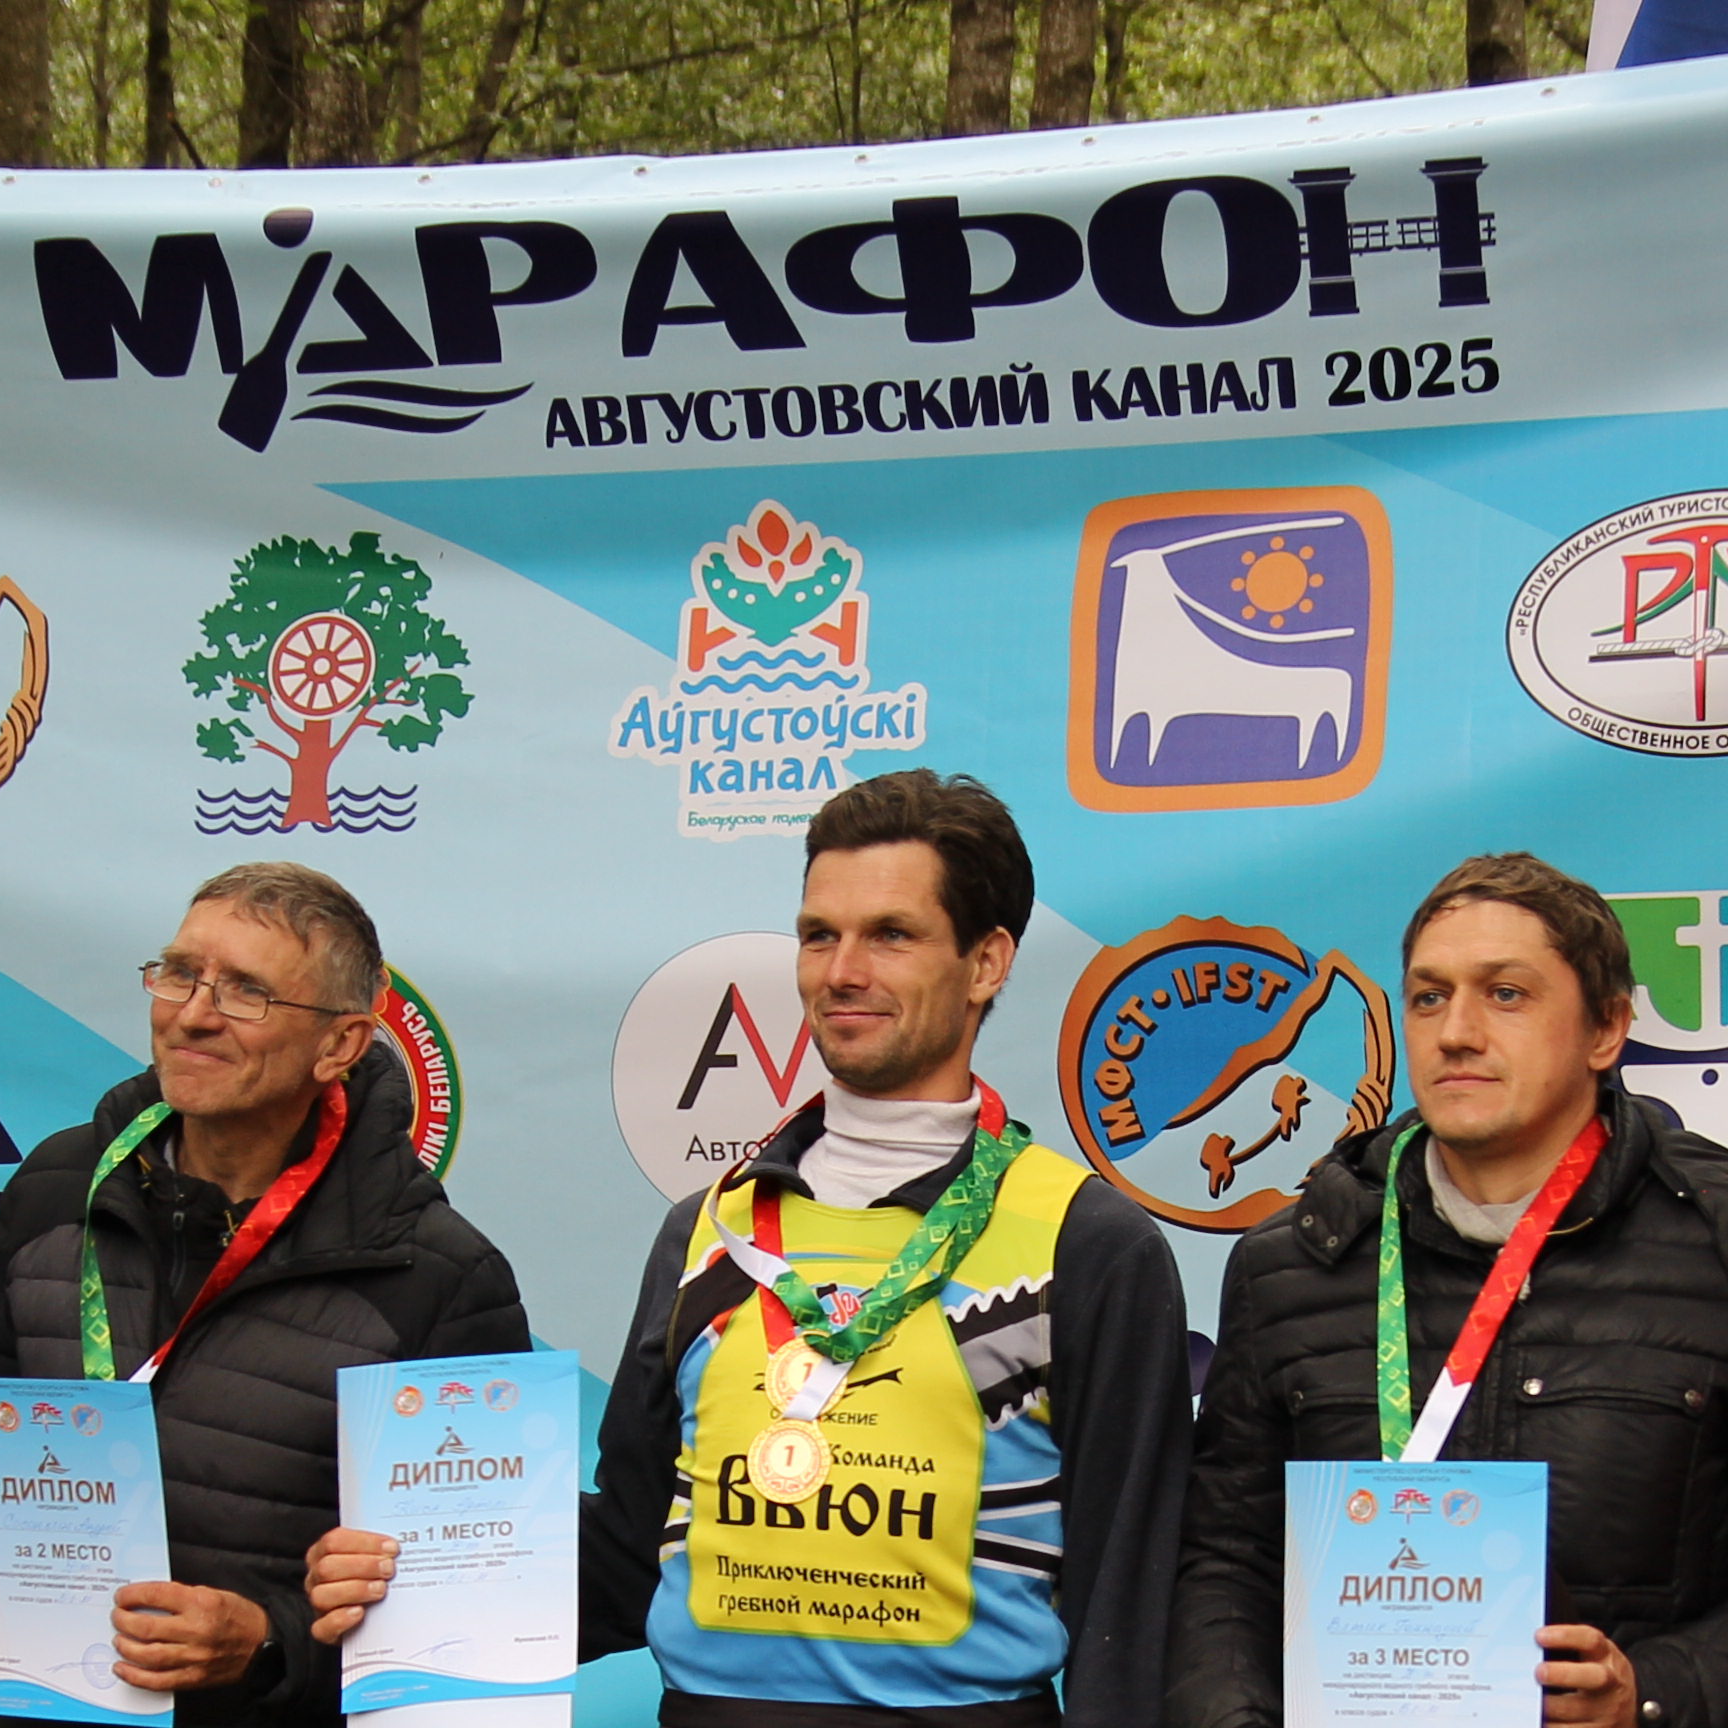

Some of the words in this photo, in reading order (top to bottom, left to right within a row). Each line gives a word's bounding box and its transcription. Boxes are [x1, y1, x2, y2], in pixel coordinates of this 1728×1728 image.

[34, 157, 1496, 452] МАРАФОН
[546, 362, 1050, 449] АВГУСТОВСКИЙ
[1071, 356, 1296, 422] КАНАЛ
[1326, 338, 1500, 408] 2025
[1567, 706, 1710, 750] ОБЩЕСТВЕННОЕ
[689, 756, 837, 794] канал
[400, 1001, 452, 1113] БЕЛАРУСЬ
[685, 1133, 764, 1162] Авто
[389, 1456, 524, 1491] ДИПЛОМ
[828, 1443, 935, 1475] Команда
[1, 1477, 116, 1505] ДИПЛОМ
[398, 1530, 419, 1543] за
[425, 1526, 434, 1541] 1
[442, 1520, 514, 1541] МЕСТО
[15, 1545, 32, 1557] за
[37, 1543, 47, 1558] 2
[52, 1543, 112, 1562] МЕСТО
[717, 1554, 926, 1590] Приключенческий
[1339, 1575, 1482, 1606] ДИПЛОМ
[718, 1595, 801, 1616] гребной
[808, 1600, 921, 1627] марафон
[1347, 1651, 1368, 1665] за
[1375, 1649, 1386, 1666] 3
[1393, 1648, 1470, 1667] МЕСТО
